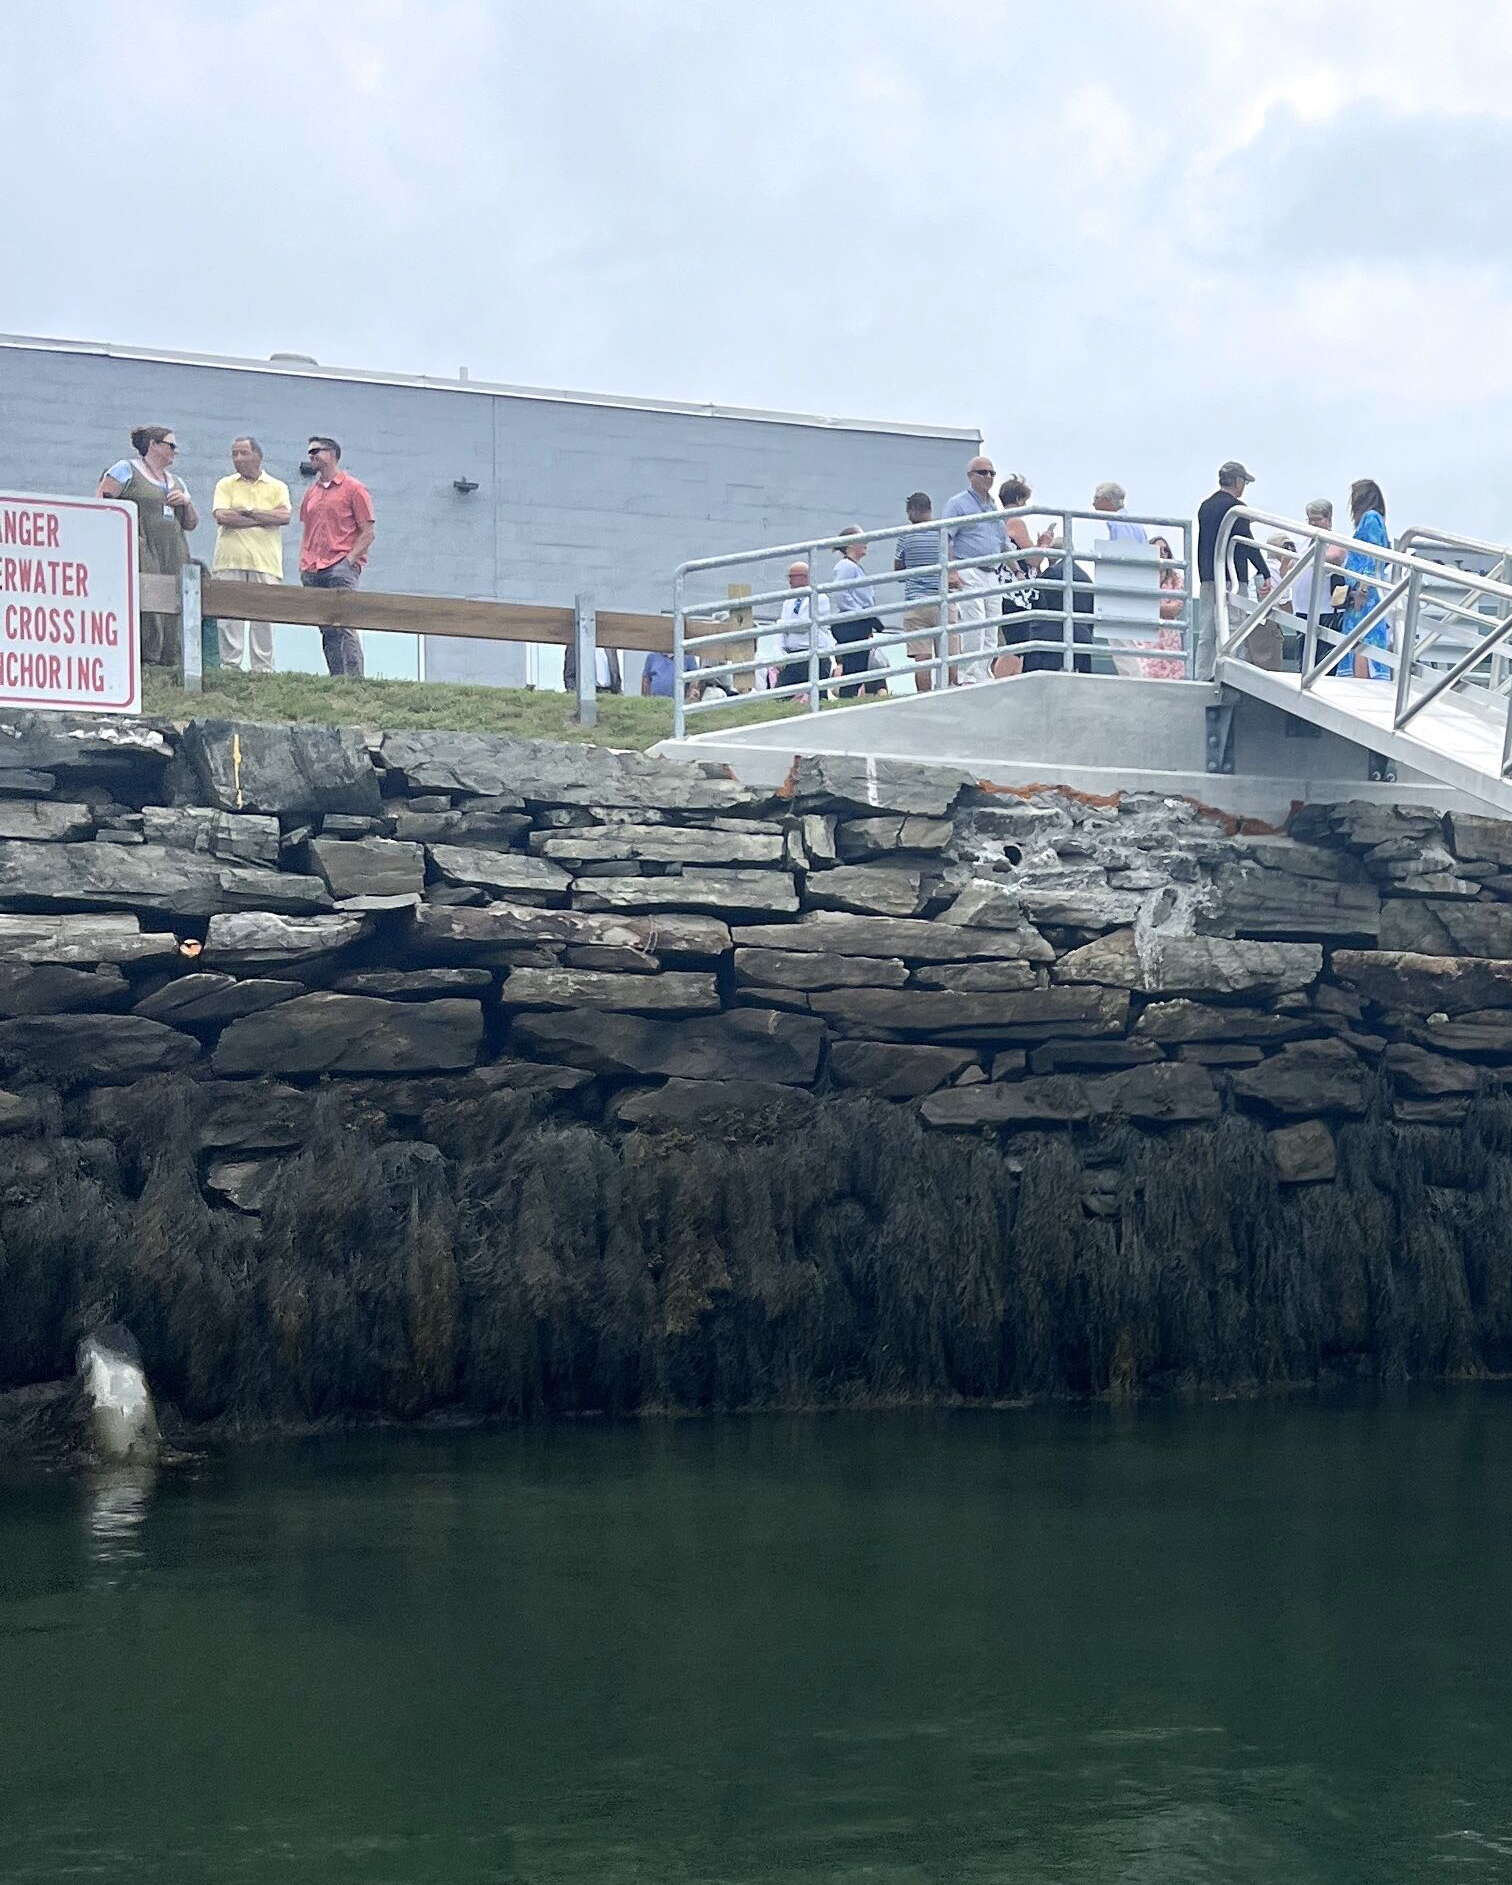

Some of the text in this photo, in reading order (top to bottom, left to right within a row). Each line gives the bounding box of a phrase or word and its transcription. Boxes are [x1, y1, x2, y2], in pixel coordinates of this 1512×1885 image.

[0, 510, 58, 547] NGER
[0, 558, 87, 597] RWATER
[5, 604, 118, 646] CROSSING
